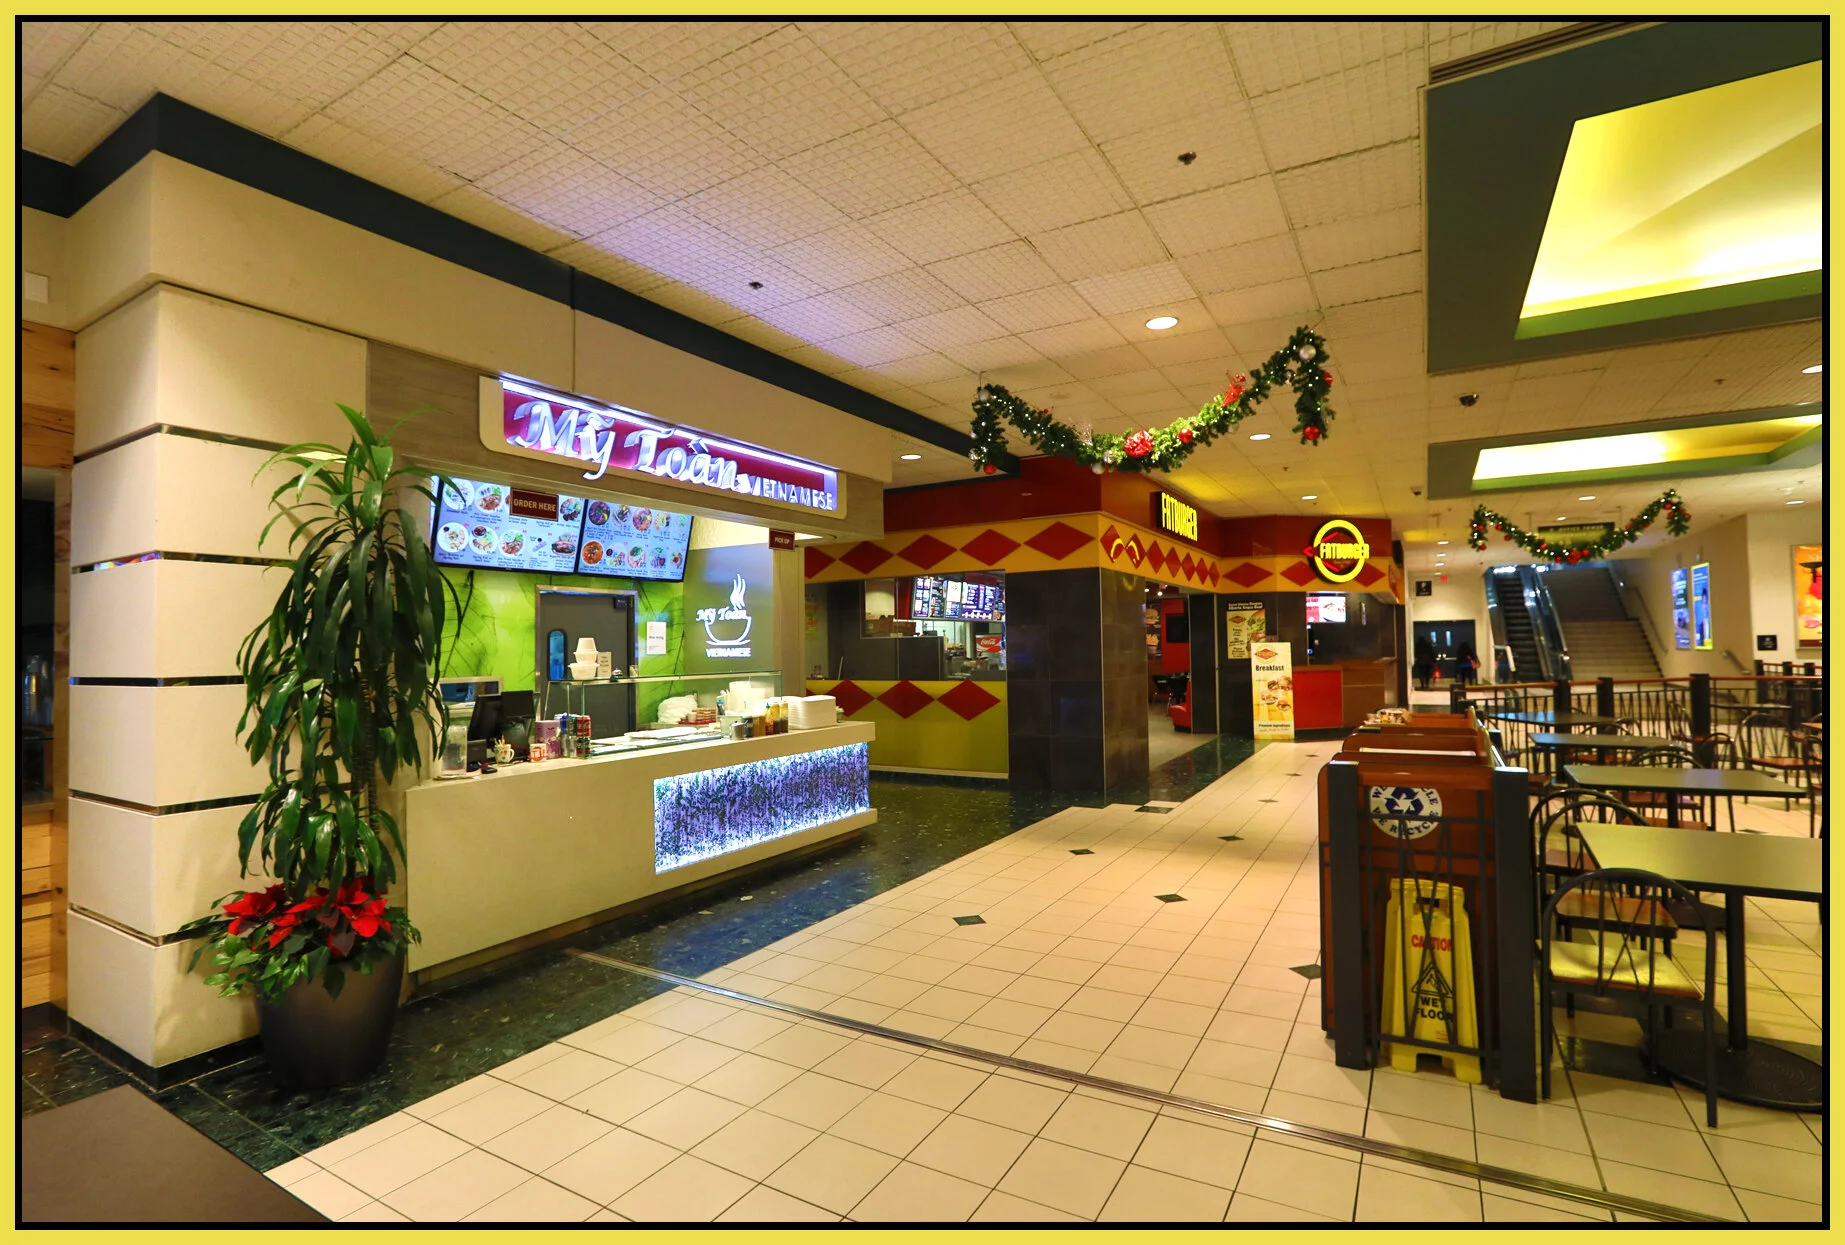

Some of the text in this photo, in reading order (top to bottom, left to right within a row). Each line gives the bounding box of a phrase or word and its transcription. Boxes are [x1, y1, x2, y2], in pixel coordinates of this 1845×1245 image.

[739, 473, 833, 511] VIETNAMESE
[513, 498, 557, 512] ORDER HERE
[1161, 491, 1198, 542] FATBURGER
[1319, 542, 1370, 560] FATBURGER
[705, 648, 752, 658] VIETNAMESE
[1411, 934, 1452, 952] CATION
